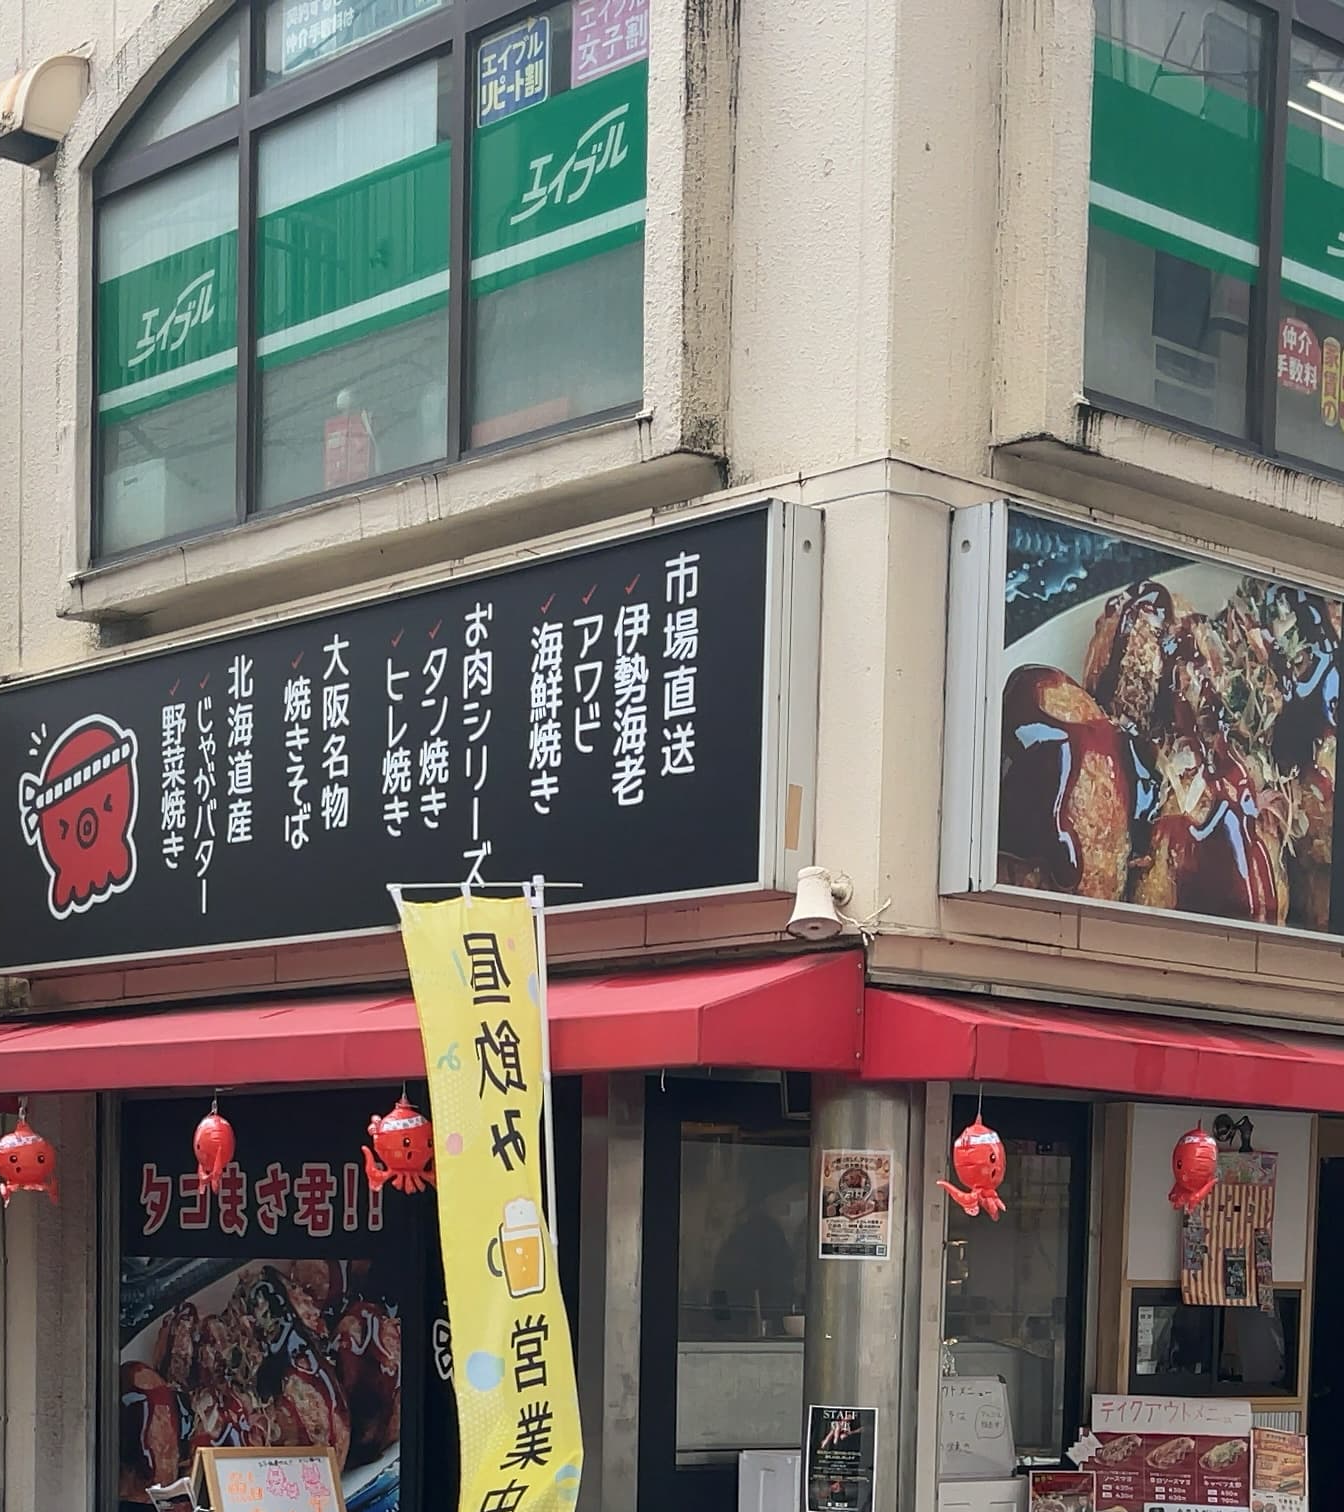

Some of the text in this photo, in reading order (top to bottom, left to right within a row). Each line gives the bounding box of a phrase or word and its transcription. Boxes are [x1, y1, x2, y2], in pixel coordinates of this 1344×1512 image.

[481, 31, 543, 77] エイブル
[481, 59, 543, 115] リピート割
[579, 7, 648, 71] 女子割
[511, 103, 629, 225] エイブル
[128, 269, 215, 367] エイブル
[1278, 355, 1317, 390] 手数料
[1283, 325, 1312, 356] 仲介
[320, 633, 350, 830] 大阪名物
[382, 659, 413, 837] ヒレ焼き
[419, 646, 450, 829] タン焼き
[461, 602, 494, 888] お肉シリーズ
[528, 622, 564, 816] 海鮮焼き
[572, 614, 604, 755] アワビ
[610, 603, 650, 806] 伊勢海老
[660, 551, 700, 776] 市場直送
[161, 704, 186, 869] 野菜焼き
[193, 698, 217, 914] じゃがバター
[226, 655, 253, 844] 北海道産
[283, 675, 311, 851] 焼きそば
[1100, 1401, 1248, 1424] テイクアウトメニュー
